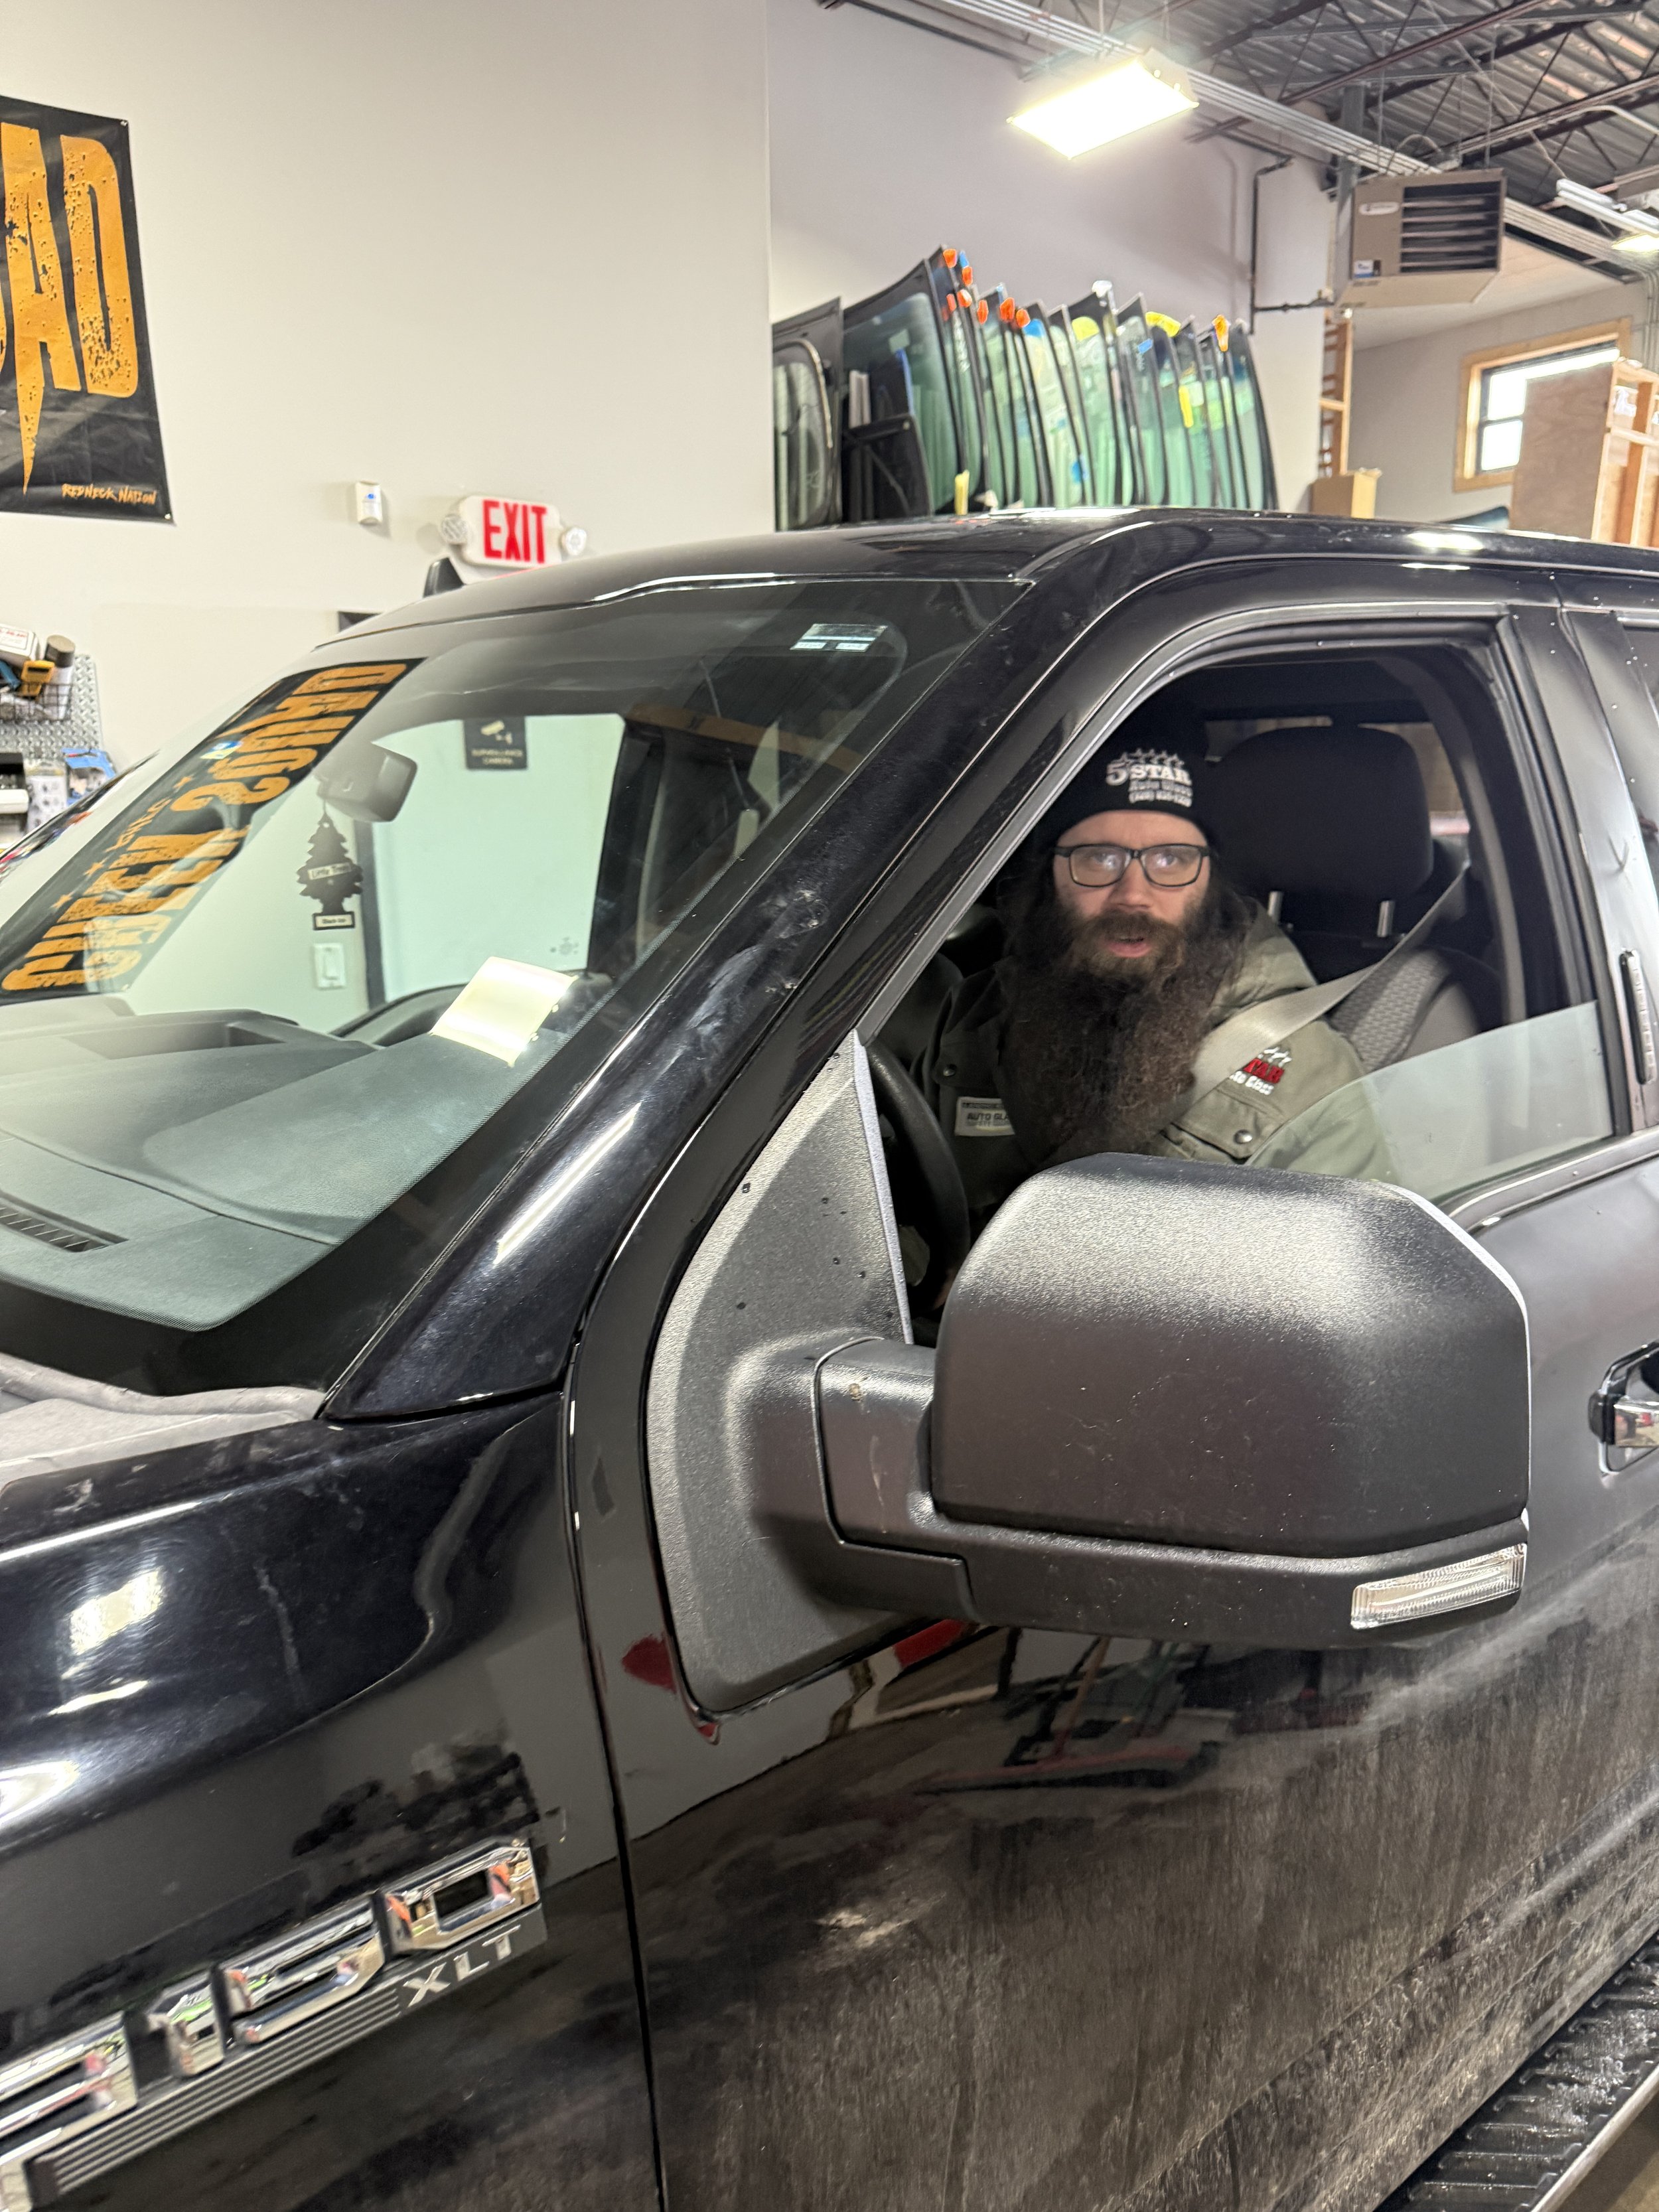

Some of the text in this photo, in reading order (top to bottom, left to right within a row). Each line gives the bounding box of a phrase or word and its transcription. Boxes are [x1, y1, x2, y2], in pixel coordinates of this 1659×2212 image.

[0, 122, 138, 494] AD
[61, 483, 157, 505] REDNECK NATION
[482, 499, 547, 564] EXIT
[1106, 762, 1192, 786] 5 STAR
[403, 1925, 521, 2008] XLT
